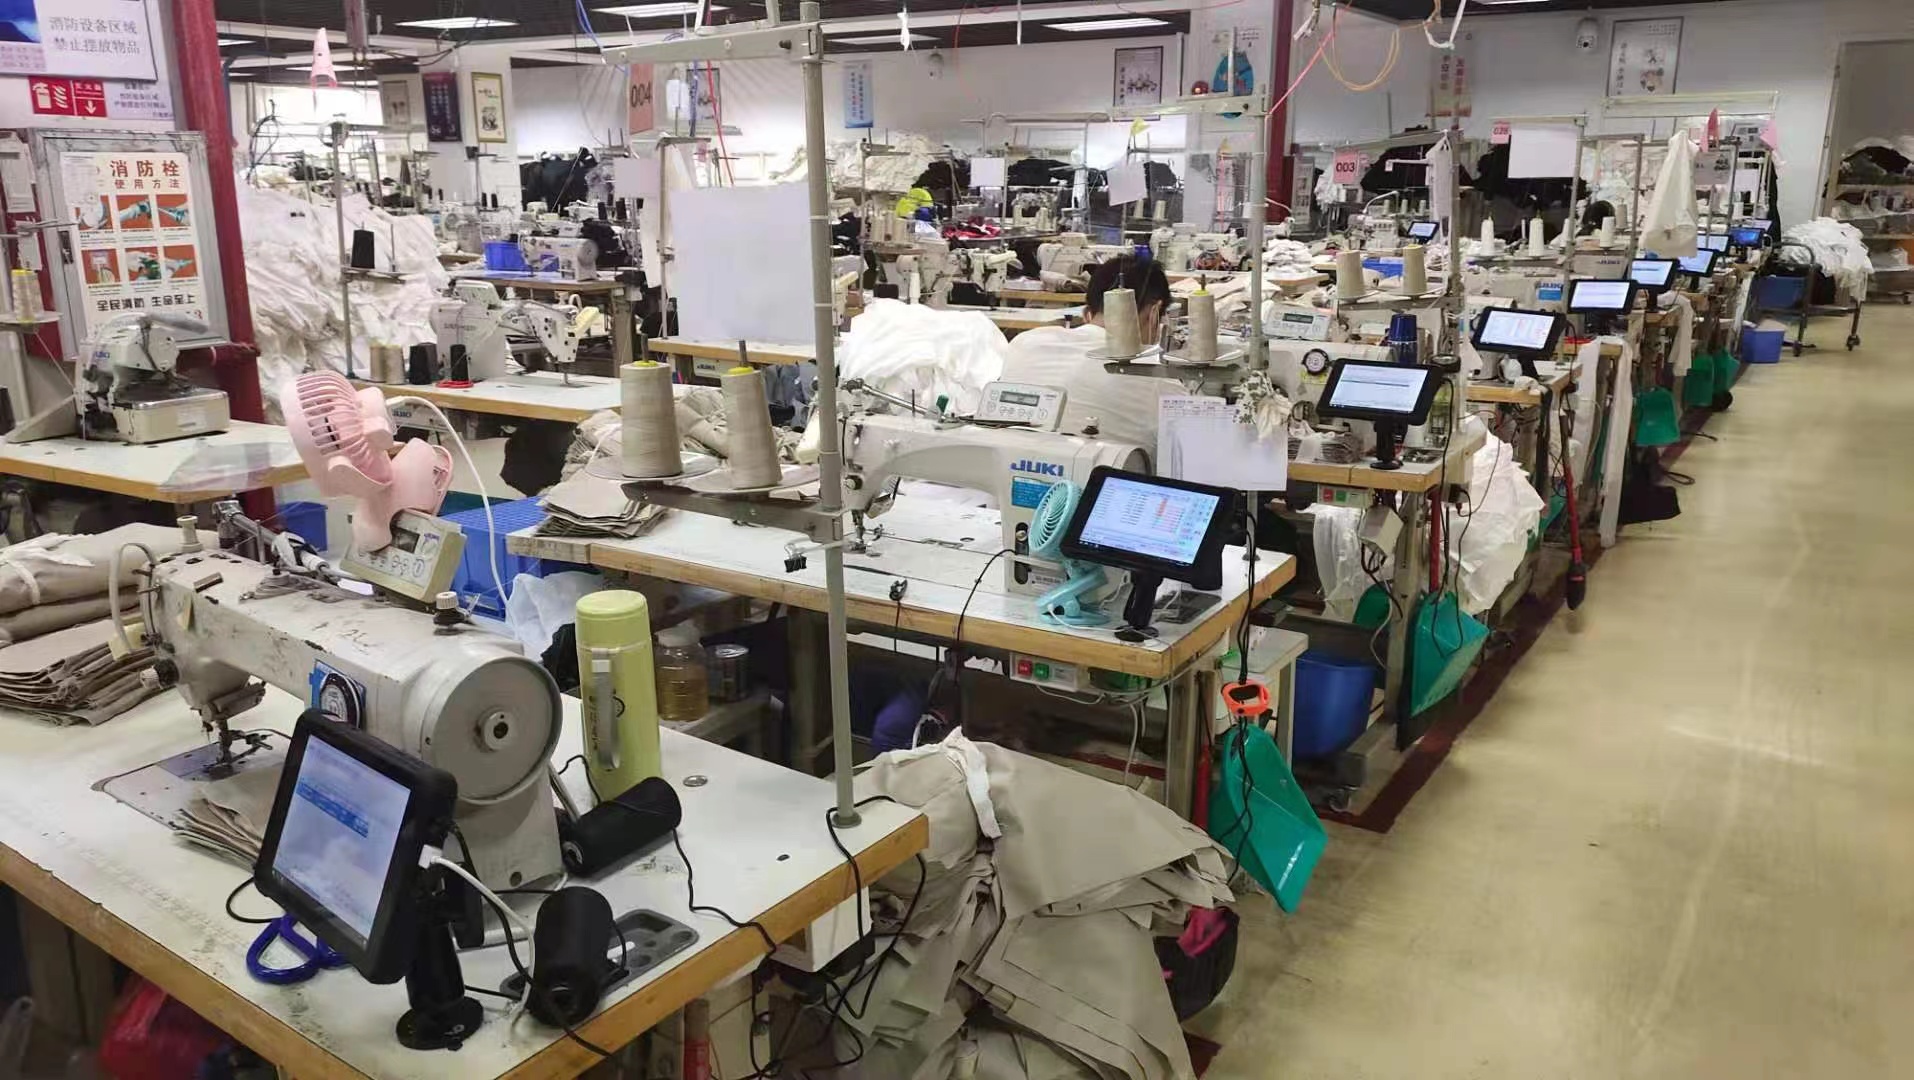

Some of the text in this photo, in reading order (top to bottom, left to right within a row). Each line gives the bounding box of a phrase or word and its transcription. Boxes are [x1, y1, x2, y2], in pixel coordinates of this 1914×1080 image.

[50, 16, 138, 35] 消防设备区域
[54, 37, 140, 55] 禁止摆放物品
[631, 81, 651, 108] 004
[110, 159, 180, 178] 消防栓
[1335, 162, 1355, 173] 003
[114, 178, 180, 190] 使用方法
[97, 294, 196, 312] 全民消防 生命至上
[1010, 460, 1064, 477] JUKI
